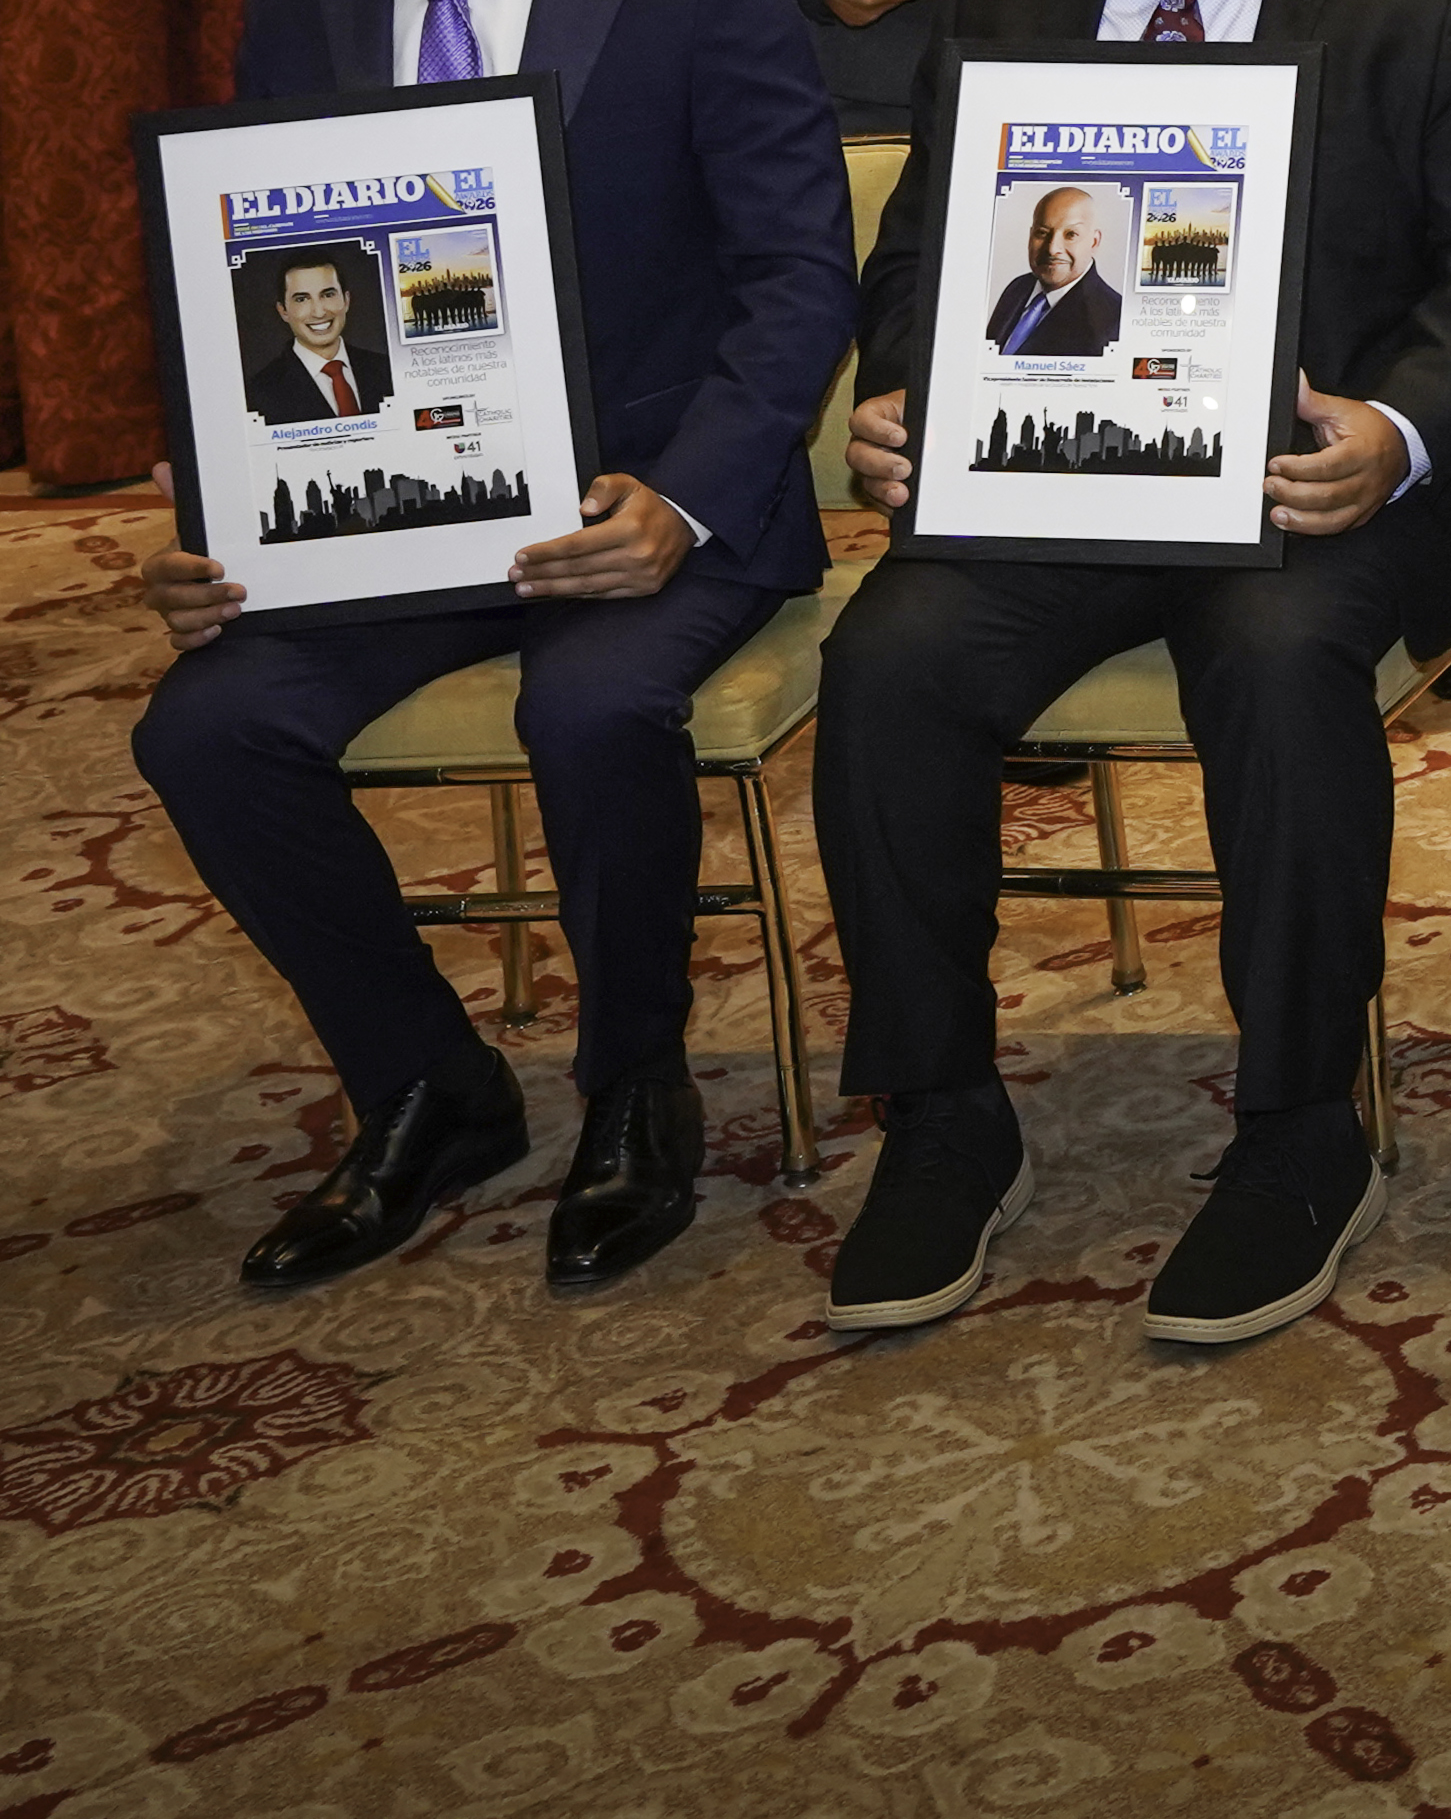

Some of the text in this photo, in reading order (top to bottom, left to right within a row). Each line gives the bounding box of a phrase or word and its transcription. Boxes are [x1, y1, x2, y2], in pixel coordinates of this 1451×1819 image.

[1008, 125, 1186, 154] EL DIARIO
[1208, 127, 1246, 149] EL
[450, 168, 492, 194] EL
[229, 175, 426, 221] EL DIARIO
[1014, 360, 1085, 371] Manuel Sáez
[1175, 396, 1187, 407] 41
[270, 419, 377, 441] Alejandro Condis
[466, 441, 481, 453] 41
